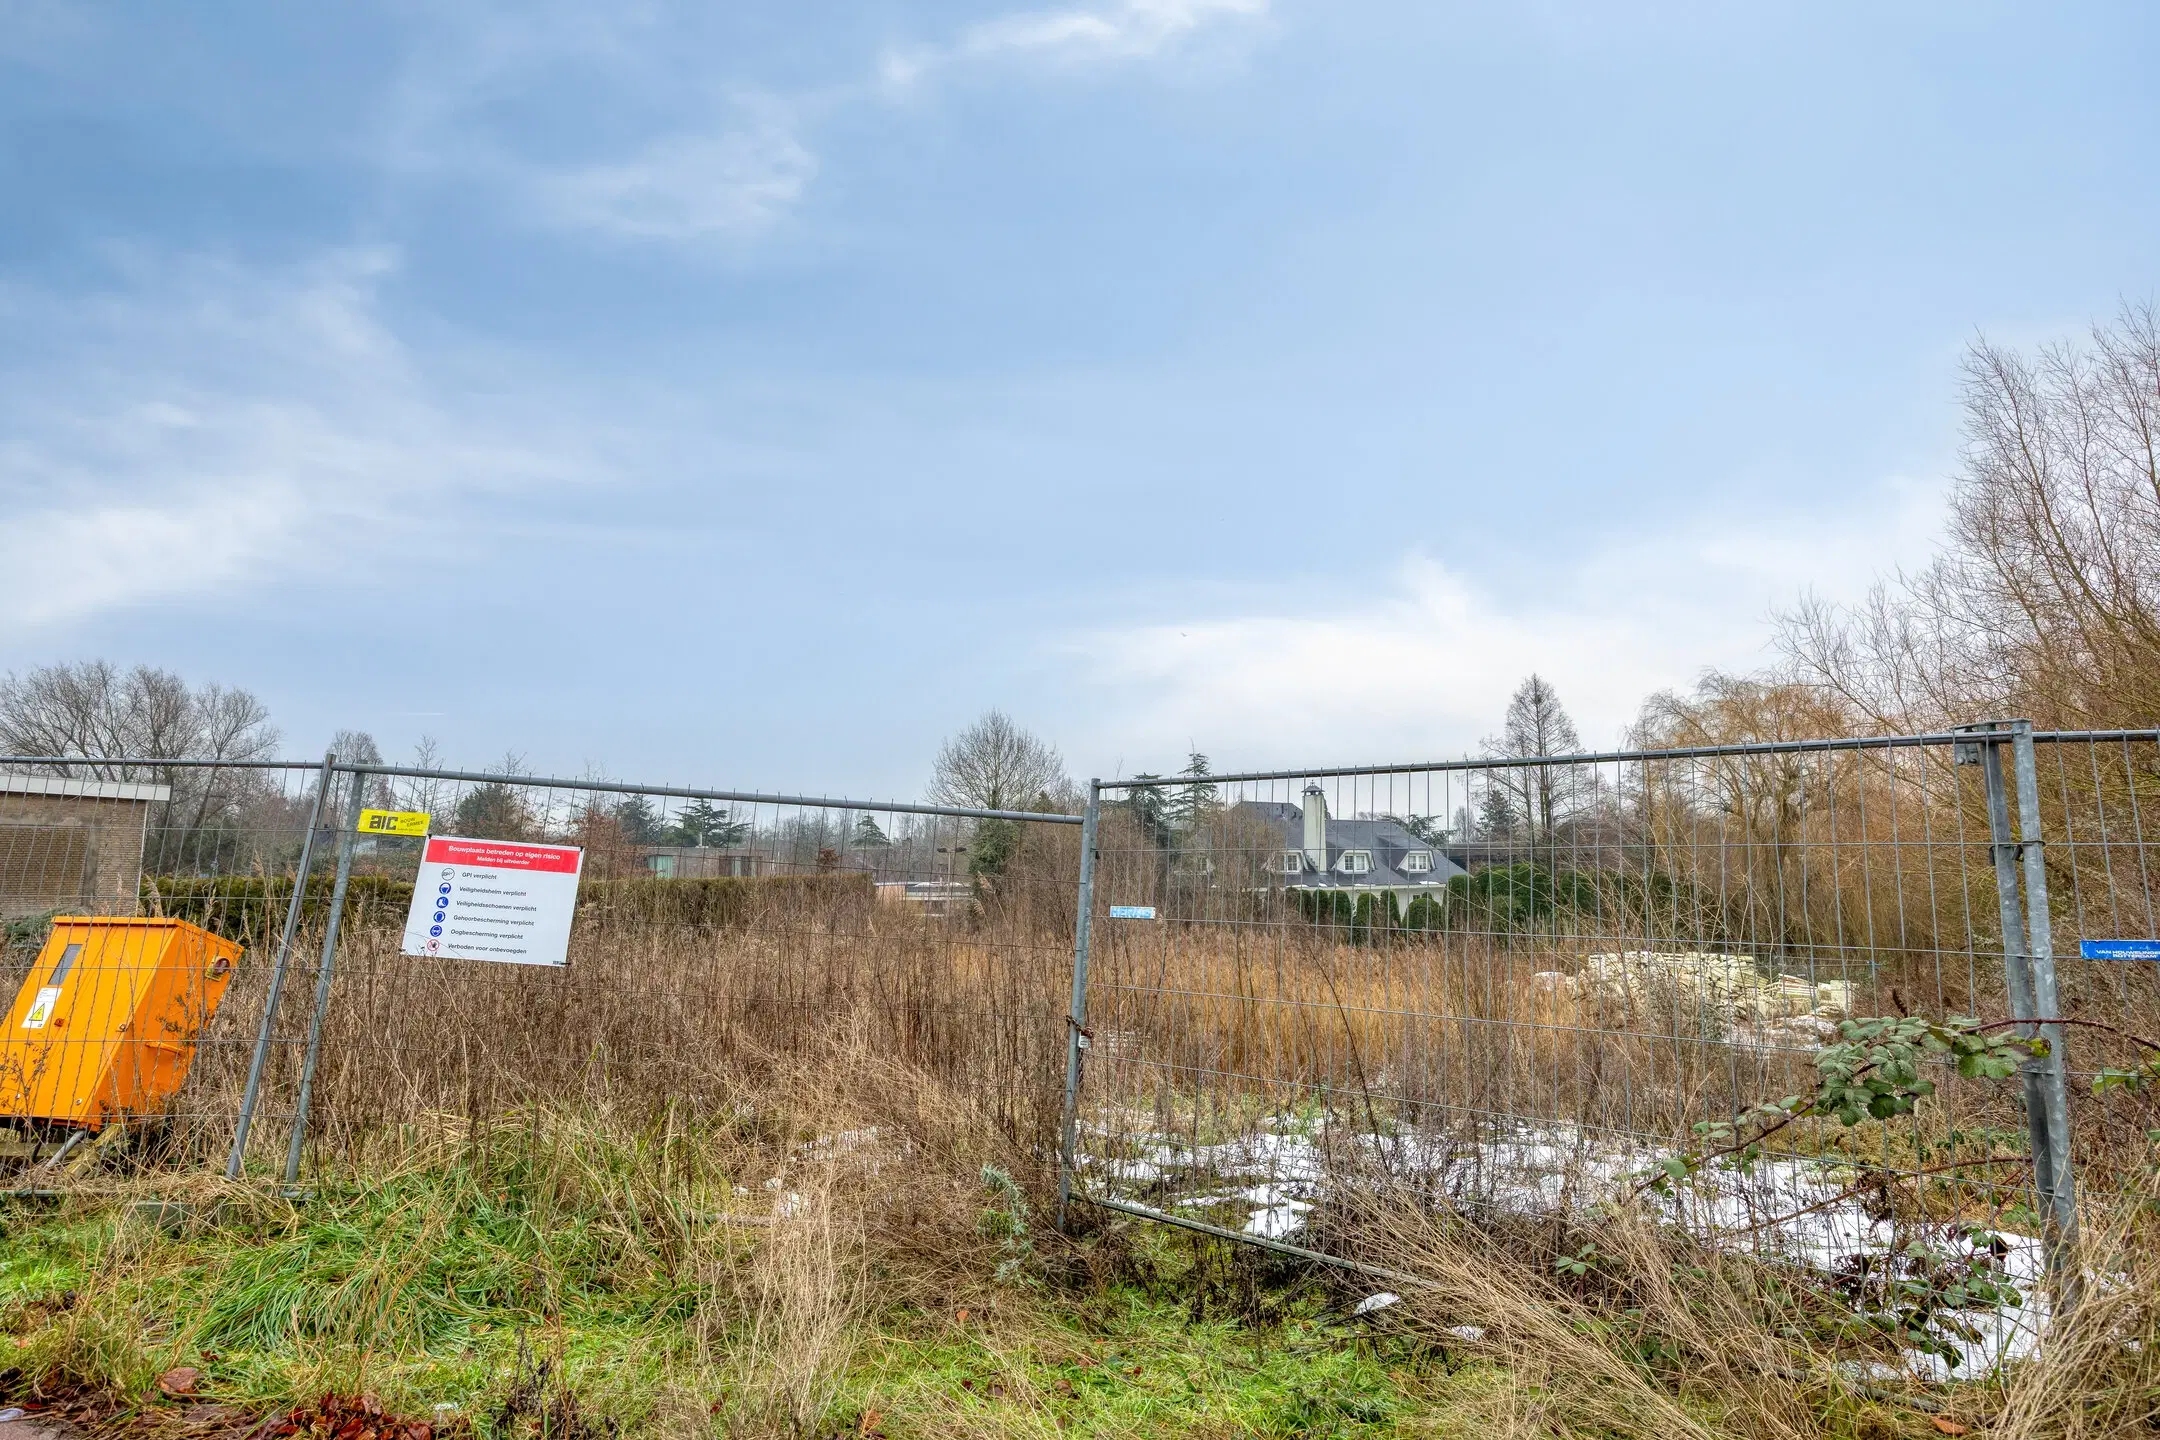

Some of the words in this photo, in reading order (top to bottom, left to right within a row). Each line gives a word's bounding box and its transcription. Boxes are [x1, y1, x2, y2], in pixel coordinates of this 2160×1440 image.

[448, 845, 485, 854] Bouwplaats
[486, 847, 514, 856] betreden
[515, 850, 524, 858] op
[524, 851, 542, 860] eigen
[459, 886, 502, 894] Veiligheidshelm
[456, 900, 512, 910] Veiligheidsschoenen
[453, 914, 510, 925] Gehoorbescherming
[450, 928, 498, 938] Oogbescherming
[489, 946, 527, 954] onbevoegden
